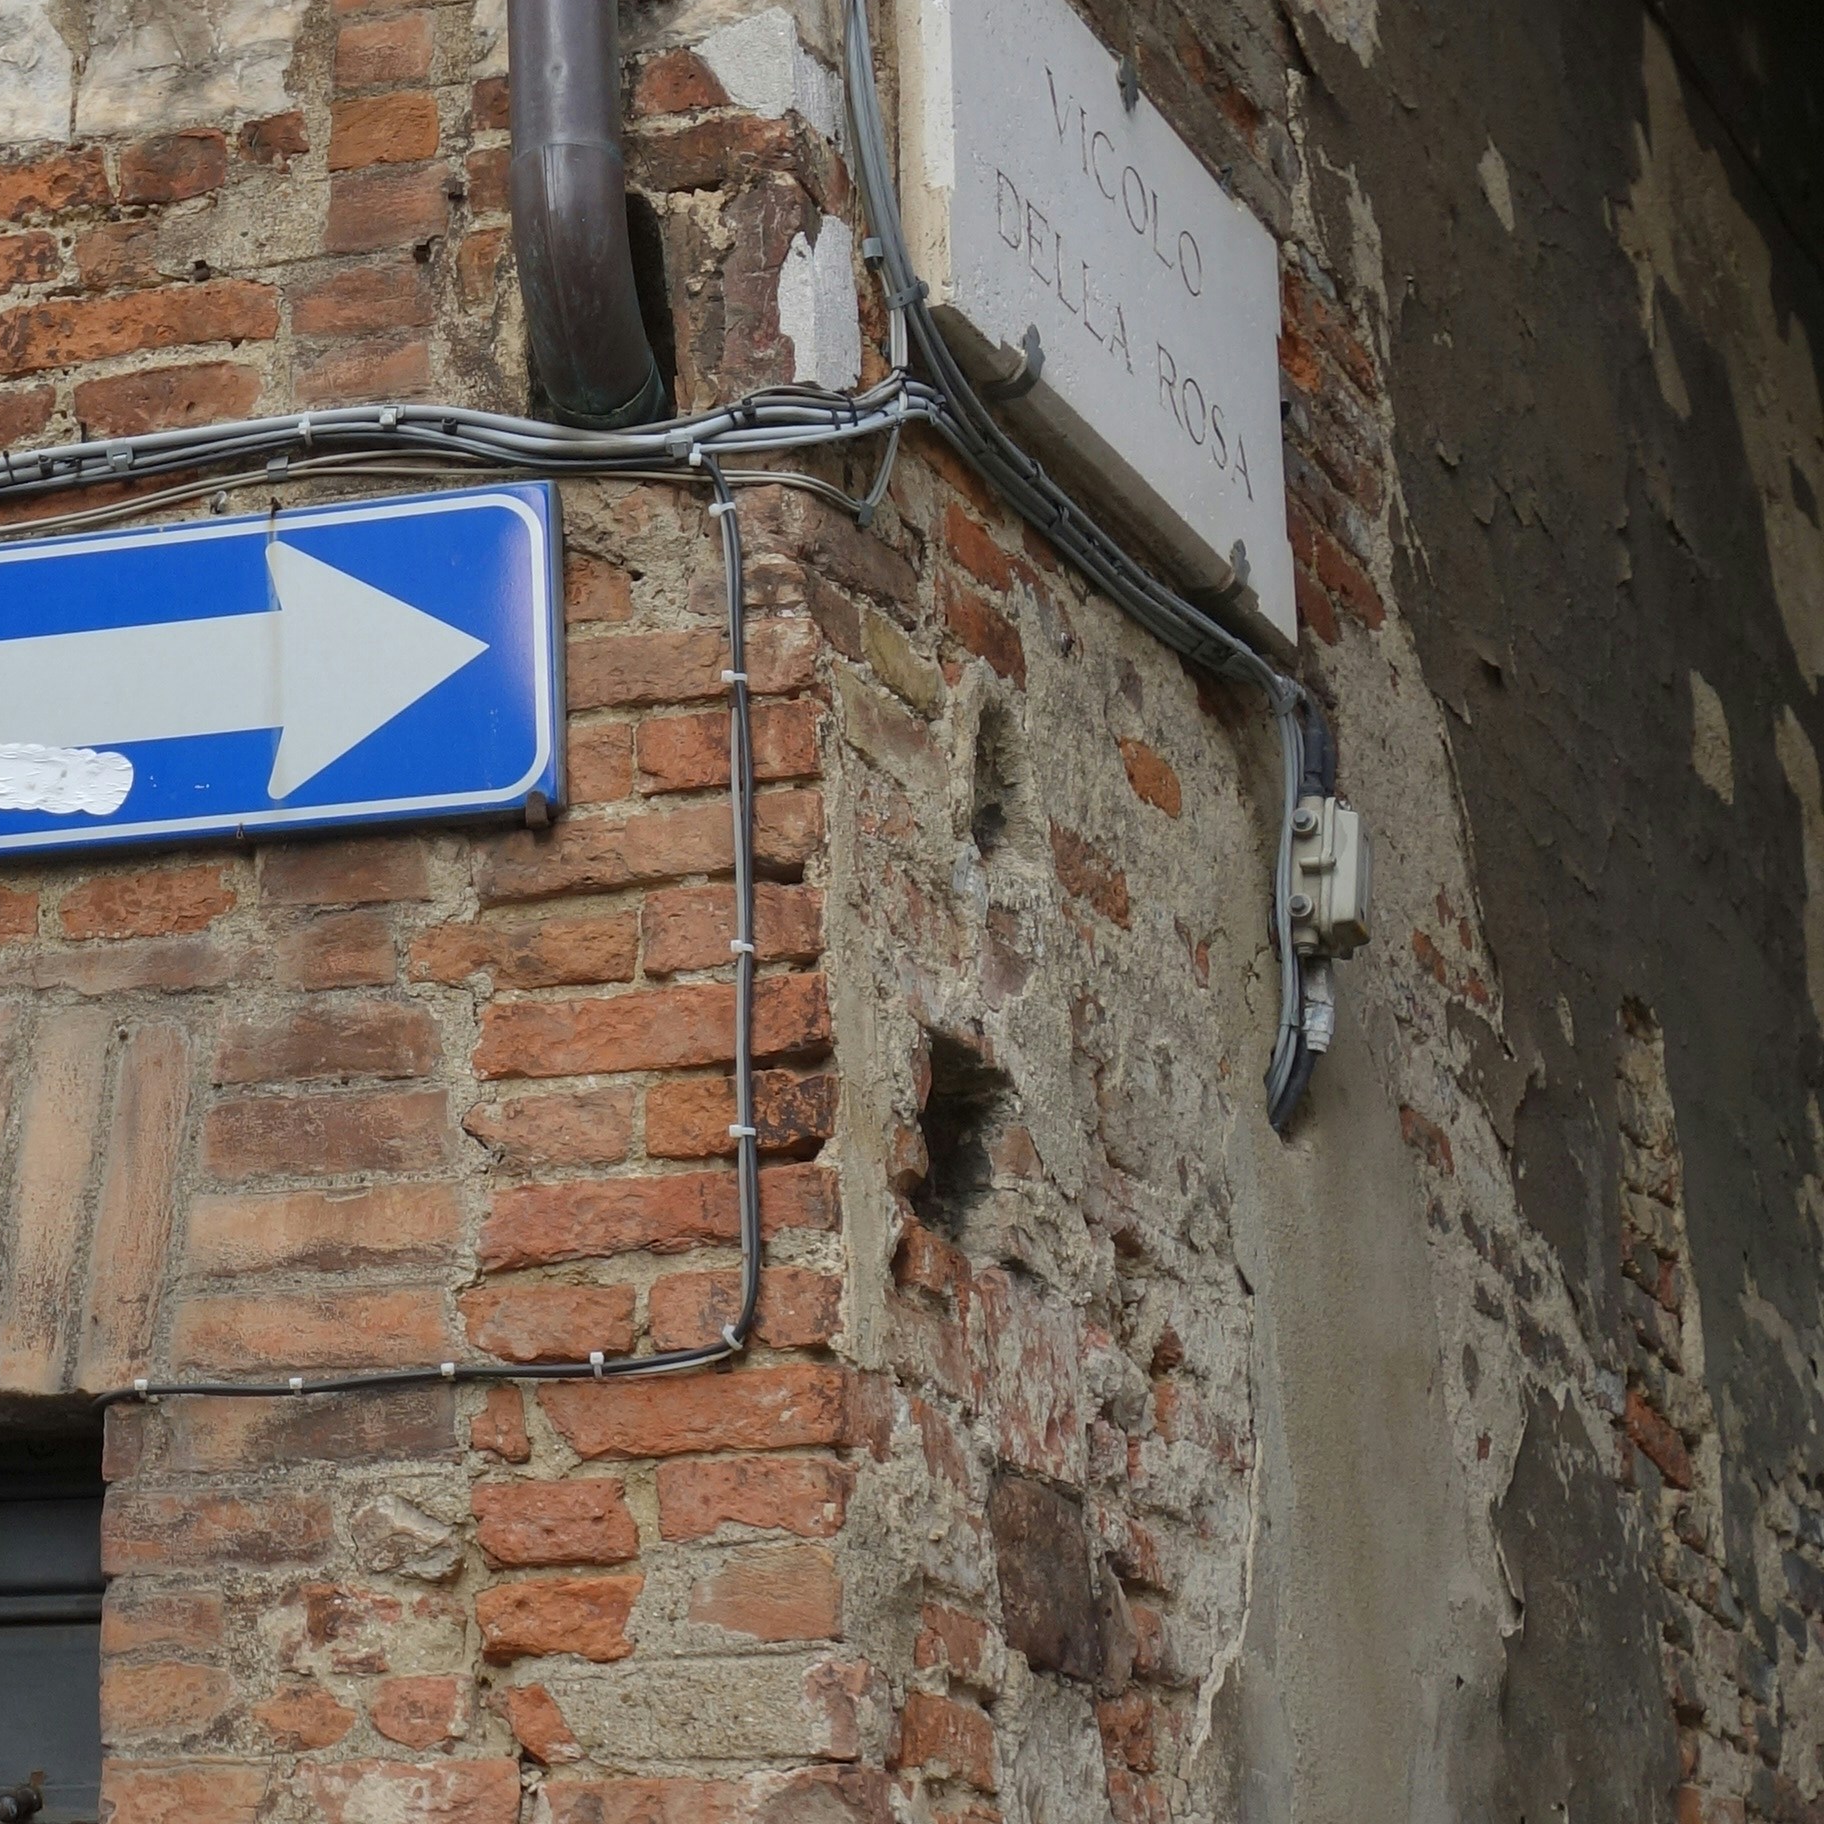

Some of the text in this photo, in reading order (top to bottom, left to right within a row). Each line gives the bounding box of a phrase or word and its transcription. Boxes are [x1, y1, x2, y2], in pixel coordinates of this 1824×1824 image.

[1044, 60, 1203, 297] VICOLO
[996, 168, 1255, 503] DELLA ROSA
